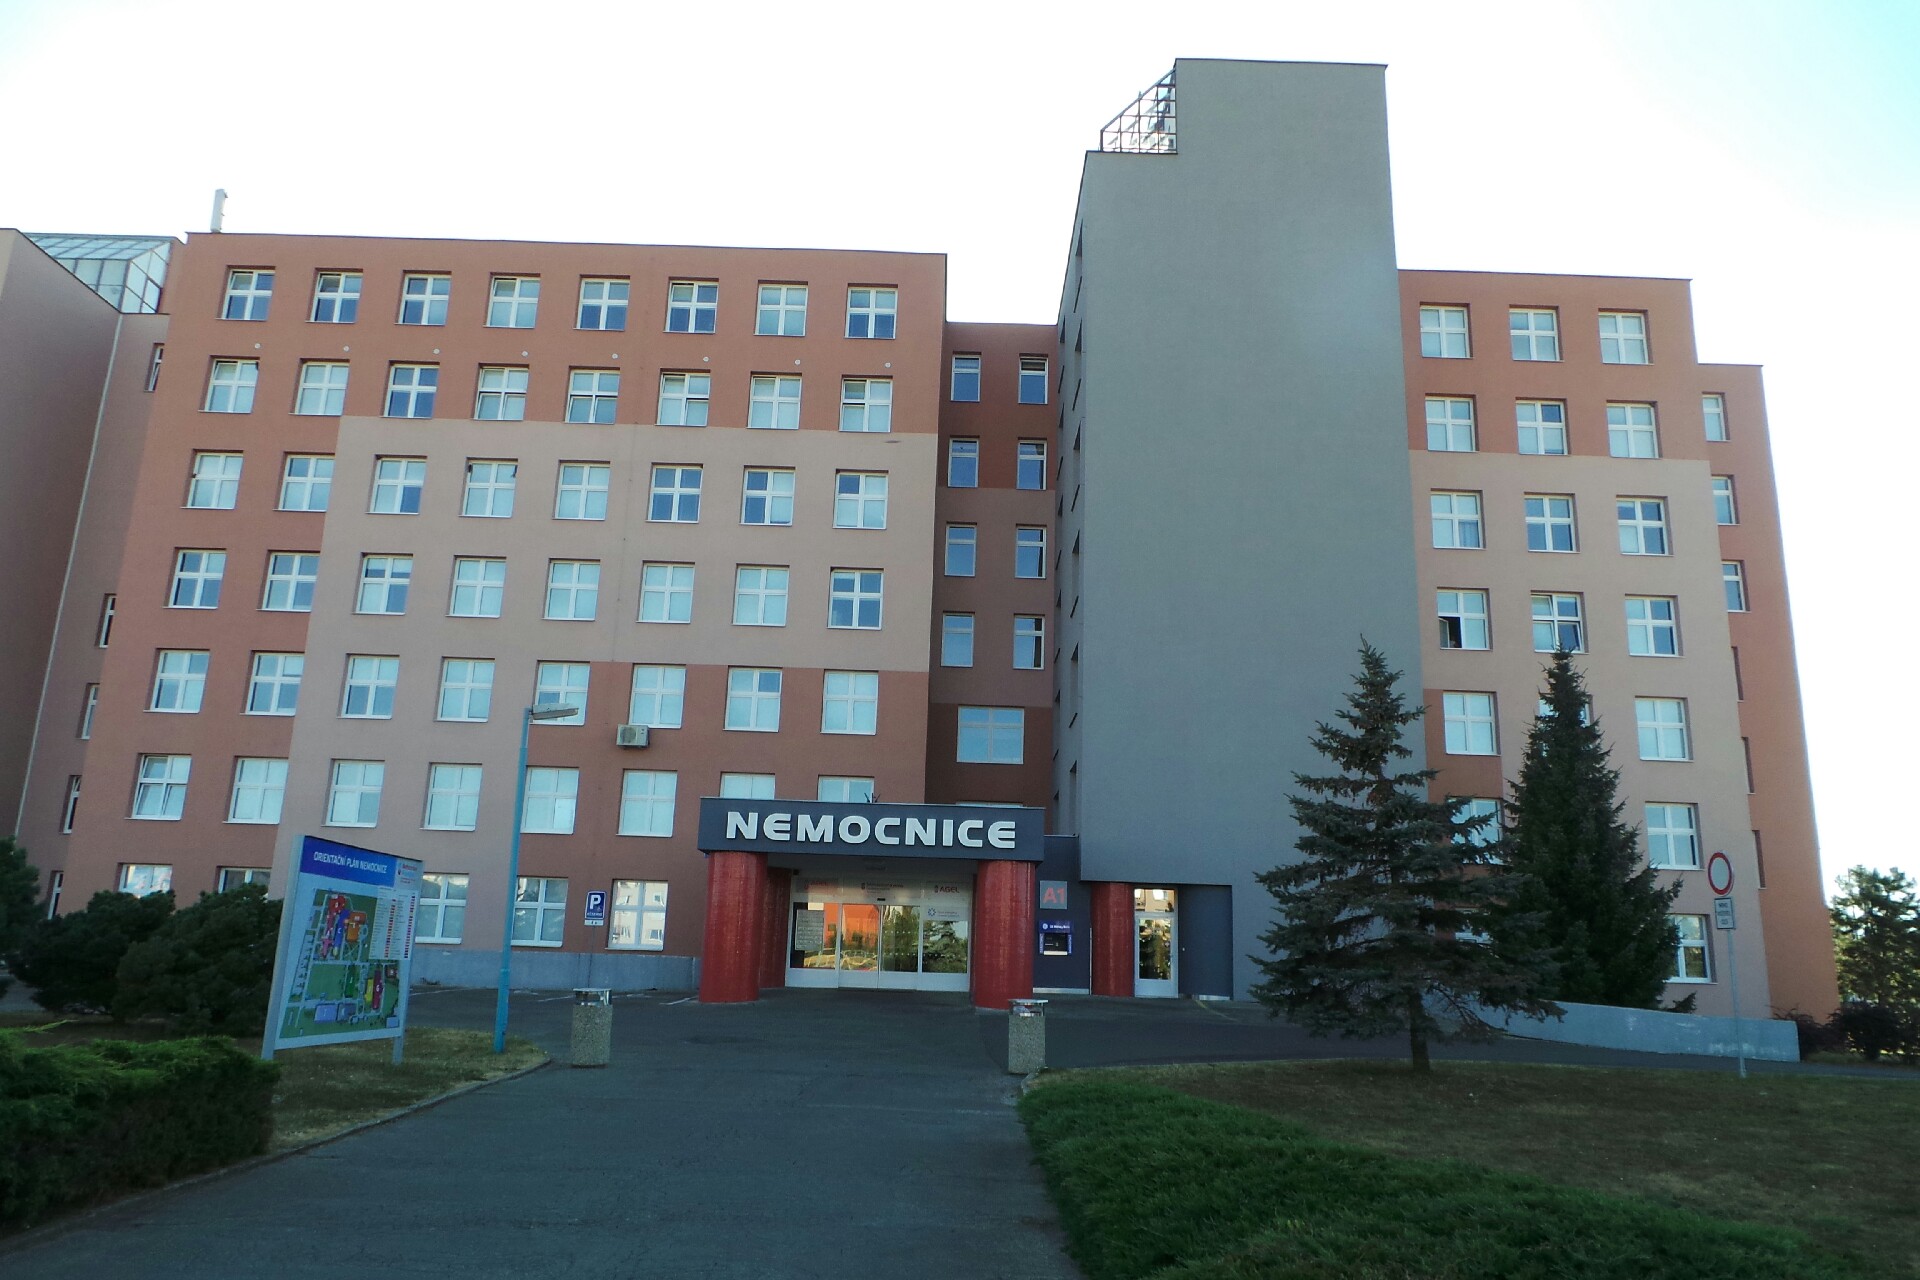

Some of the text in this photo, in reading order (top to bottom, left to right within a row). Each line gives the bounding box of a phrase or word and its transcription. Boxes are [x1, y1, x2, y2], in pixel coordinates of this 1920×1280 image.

[726, 811, 1016, 849] NEMOCNICE
[360, 860, 387, 874] NEMOCNICE
[590, 894, 601, 909] P
[1043, 887, 1065, 904] A1
